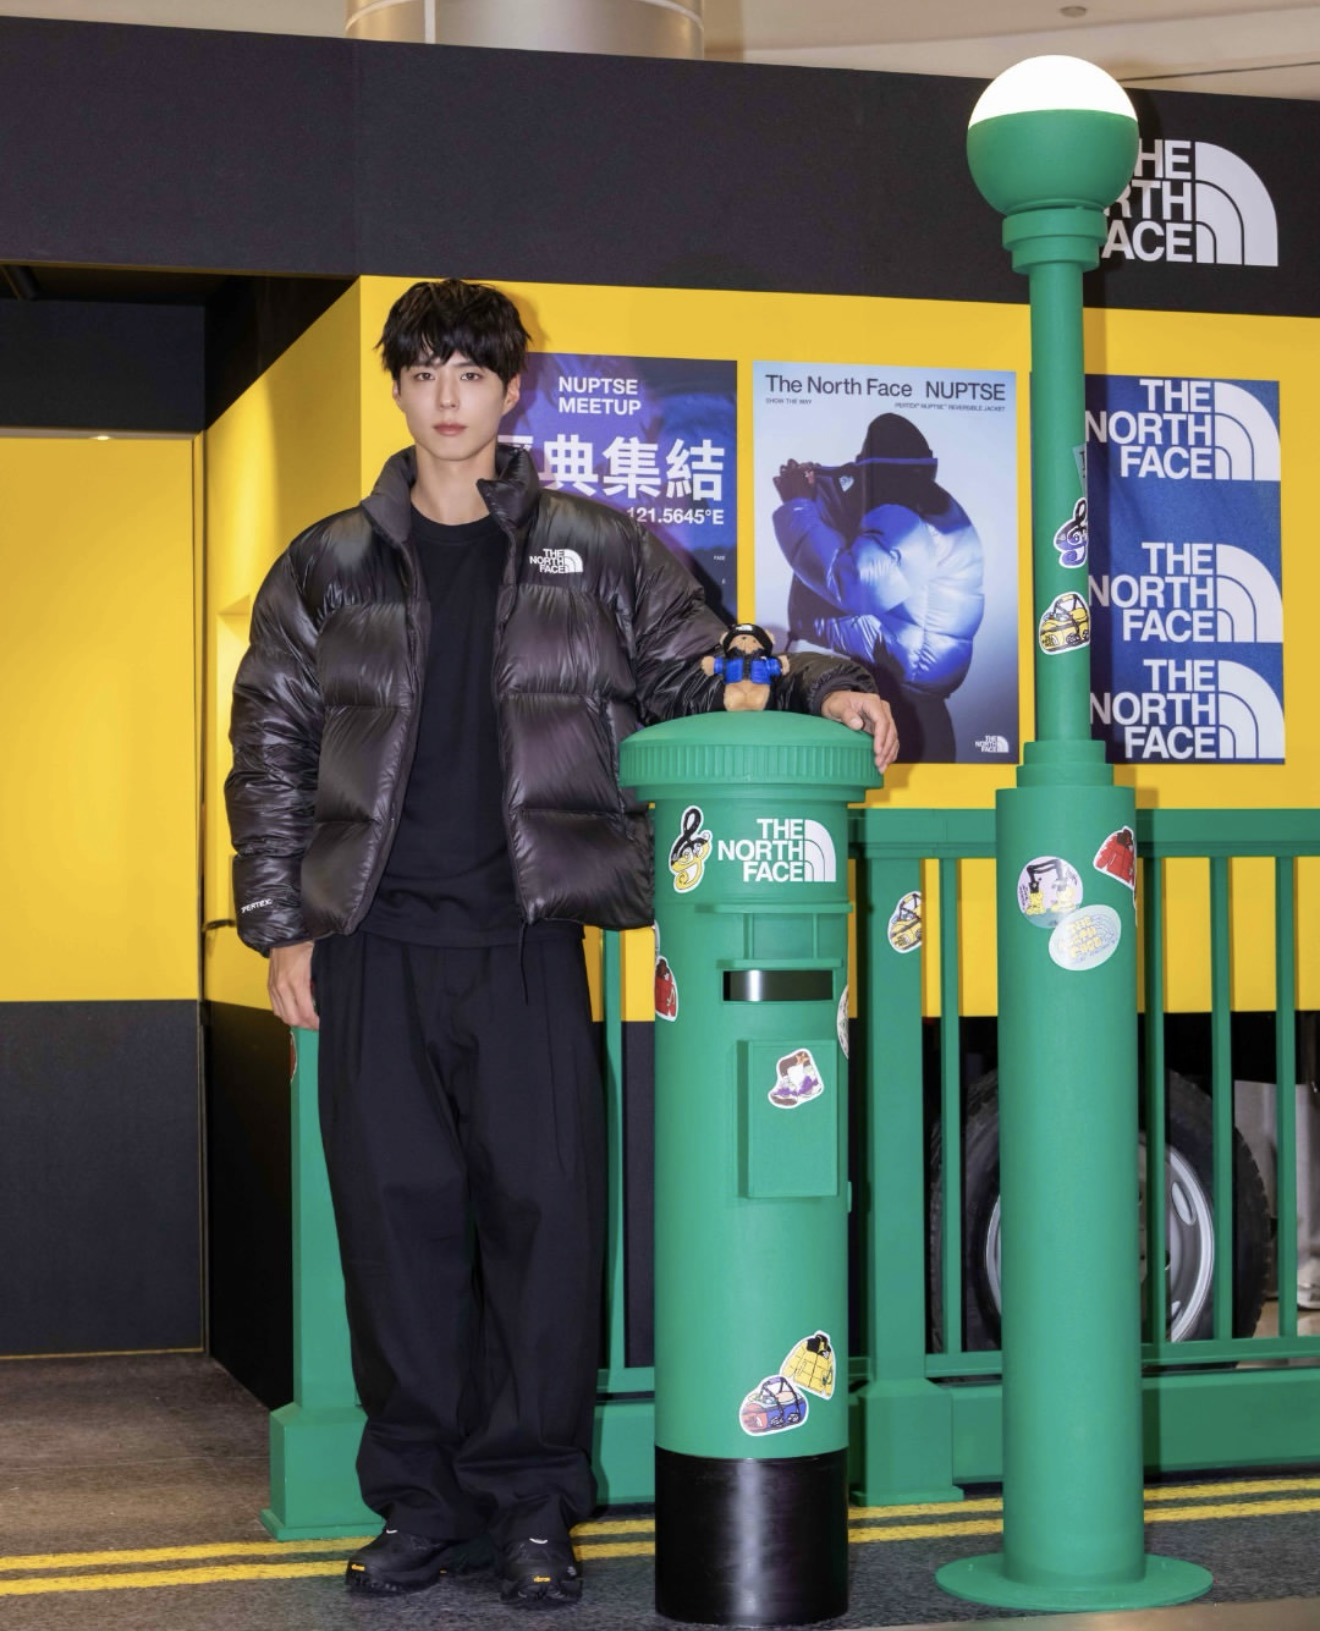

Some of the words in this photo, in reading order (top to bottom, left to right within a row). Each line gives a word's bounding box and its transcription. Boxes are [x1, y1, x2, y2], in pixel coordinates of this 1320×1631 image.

[1134, 139, 1191, 179] HE
[1101, 219, 1193, 263] ACE
[559, 376, 638, 395] NUPTSE
[765, 374, 802, 393] The
[807, 376, 862, 395] North
[867, 378, 912, 397] Face
[926, 381, 1006, 401] NUPTSE
[1140, 379, 1211, 412] THE
[559, 398, 641, 415] MEETUP
[1085, 410, 1212, 446] NORTH
[497, 433, 725, 501] 典集結
[1120, 446, 1212, 480] FACE
[529, 556, 564, 565] NORTH
[540, 565, 565, 573] FACE
[543, 549, 564, 558] THE
[1142, 542, 1213, 575] THE
[1088, 575, 1214, 609] NORTH
[1123, 610, 1214, 642] FACE
[1143, 659, 1215, 692] THE
[1090, 692, 1216, 726] NORTH
[1124, 726, 1217, 759] FACE
[757, 818, 803, 839] THE
[718, 840, 803, 861] NORTH
[743, 861, 803, 882] FACE
